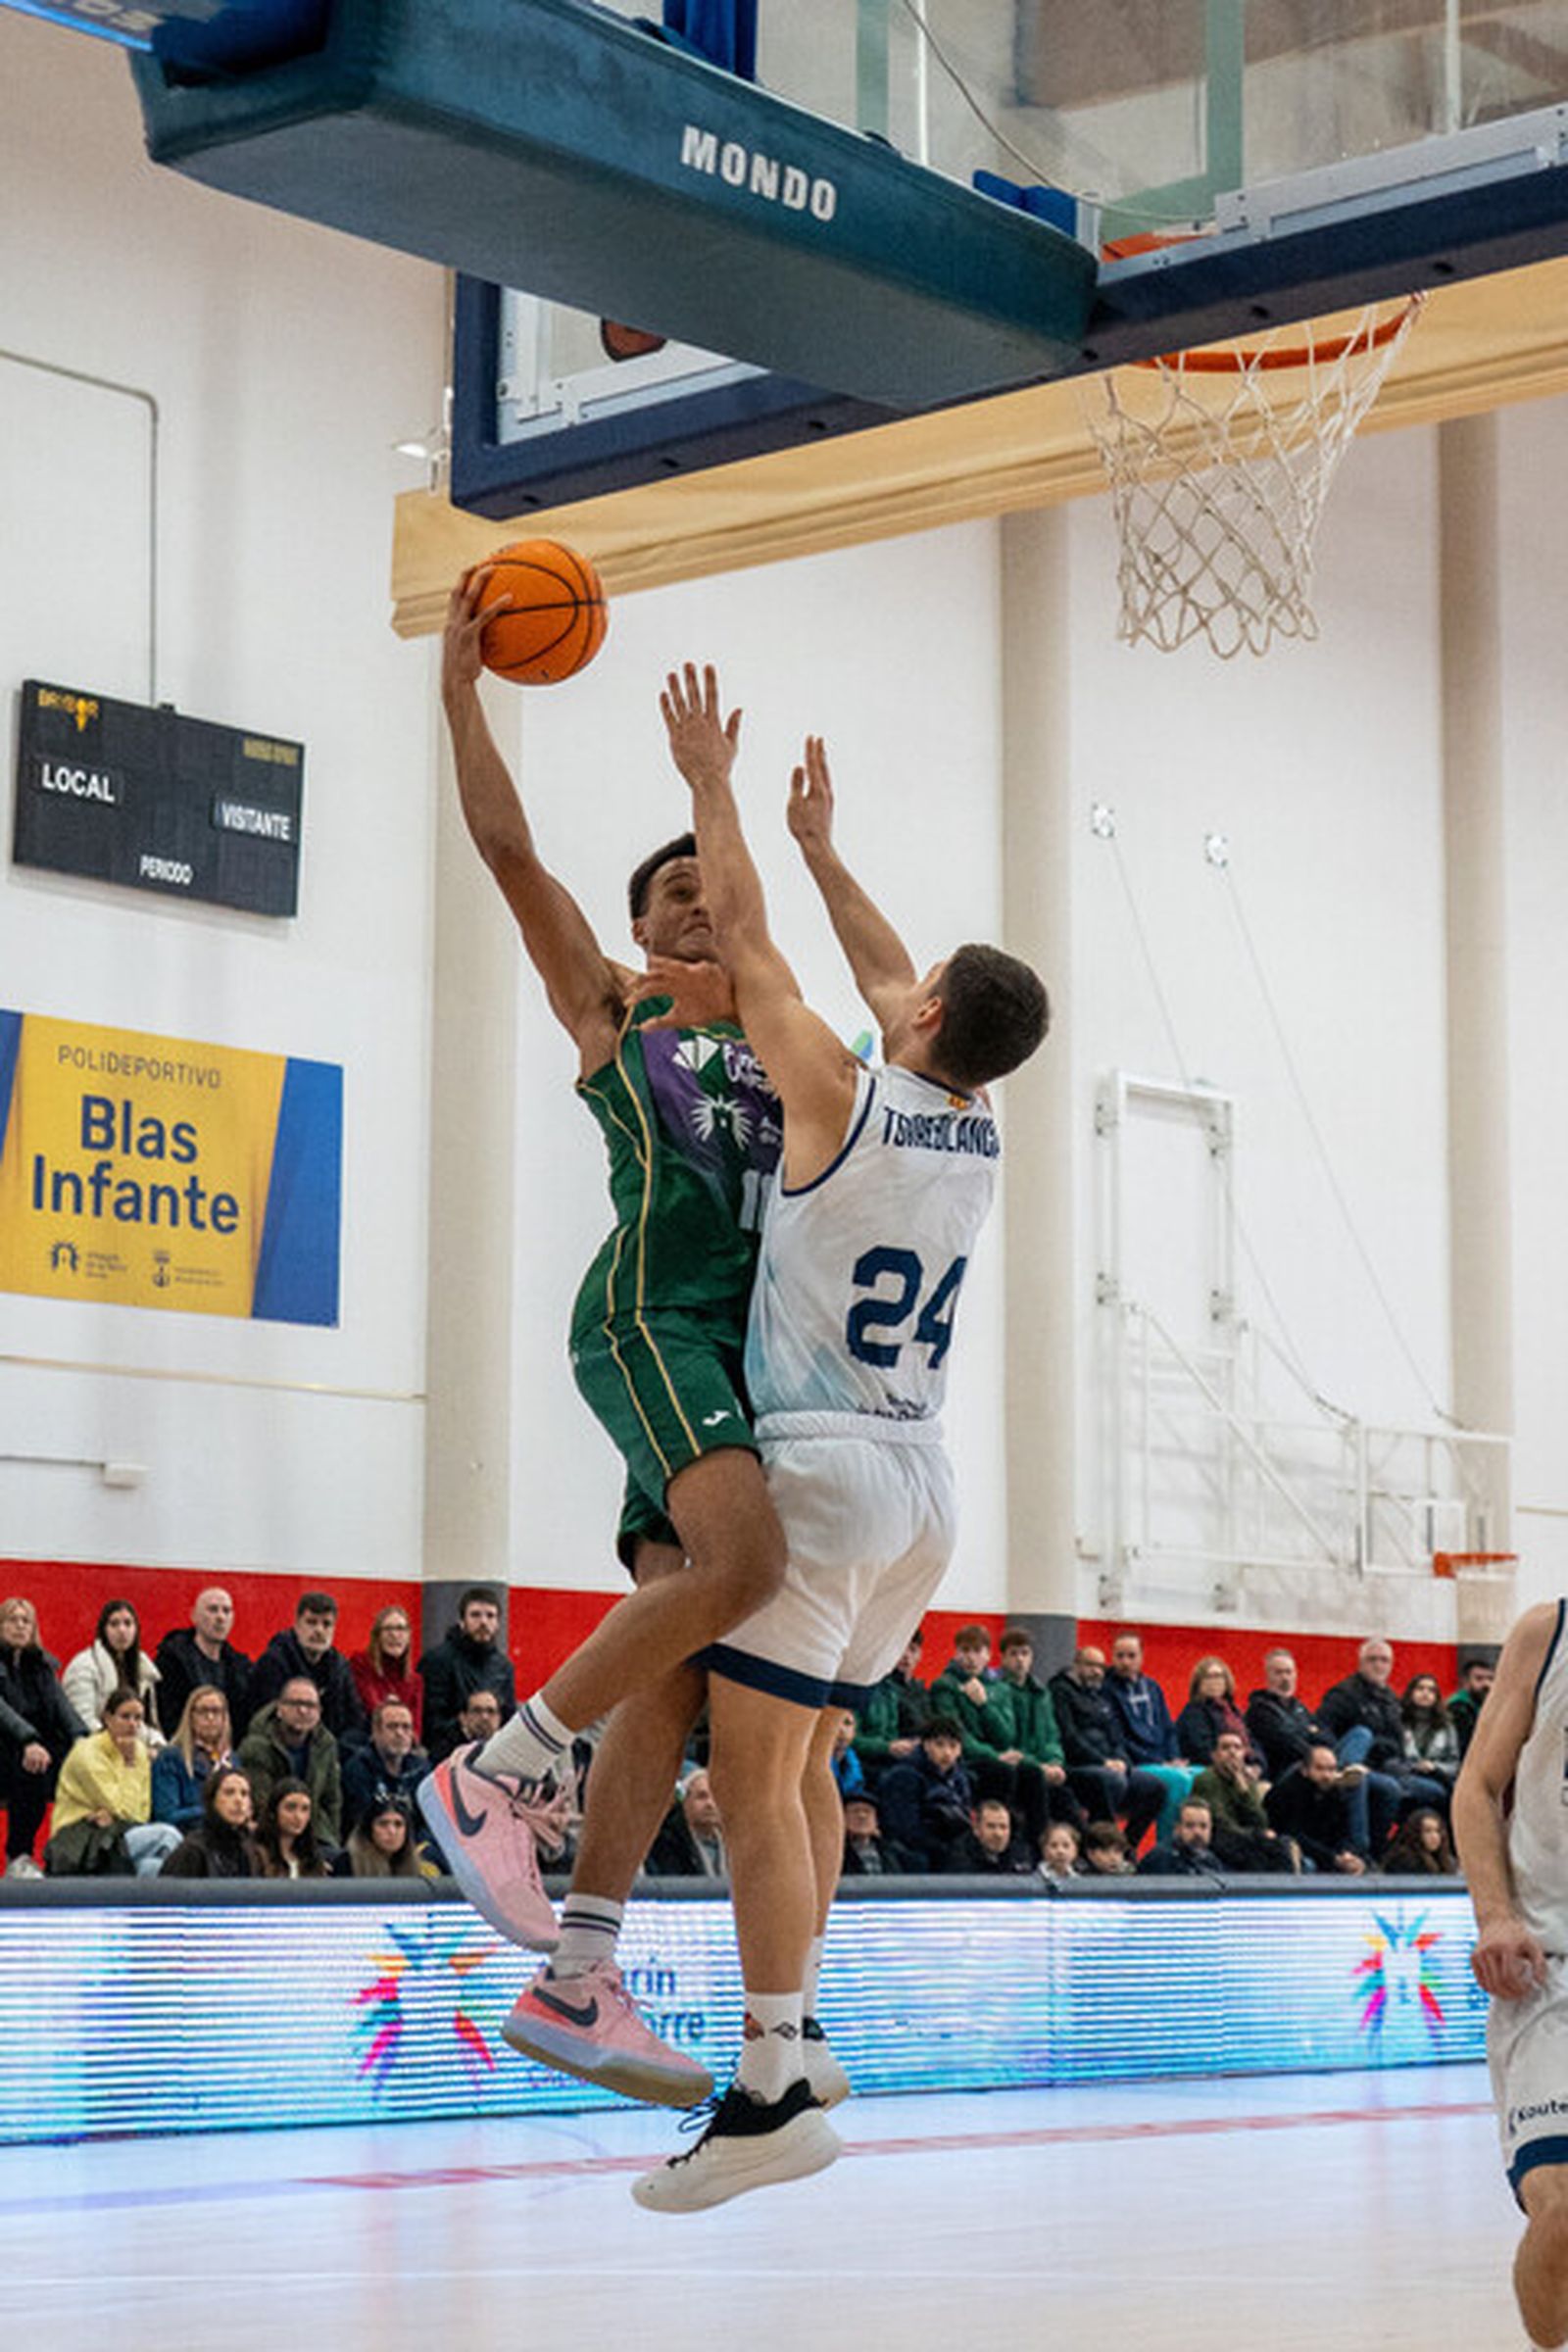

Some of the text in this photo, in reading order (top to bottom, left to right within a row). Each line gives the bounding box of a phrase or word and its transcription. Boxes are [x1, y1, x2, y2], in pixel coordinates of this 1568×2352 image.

[681, 124, 837, 221] MONDO
[42, 763, 116, 802] LOCAL
[221, 802, 292, 841] VISITANTE
[140, 856, 193, 884] PERIODO
[58, 1045, 221, 1089] POLIDEPORTIVO
[81, 1094, 198, 1163] Blas
[32, 1154, 239, 1235] Infante
[847, 1246, 967, 1369] 24
